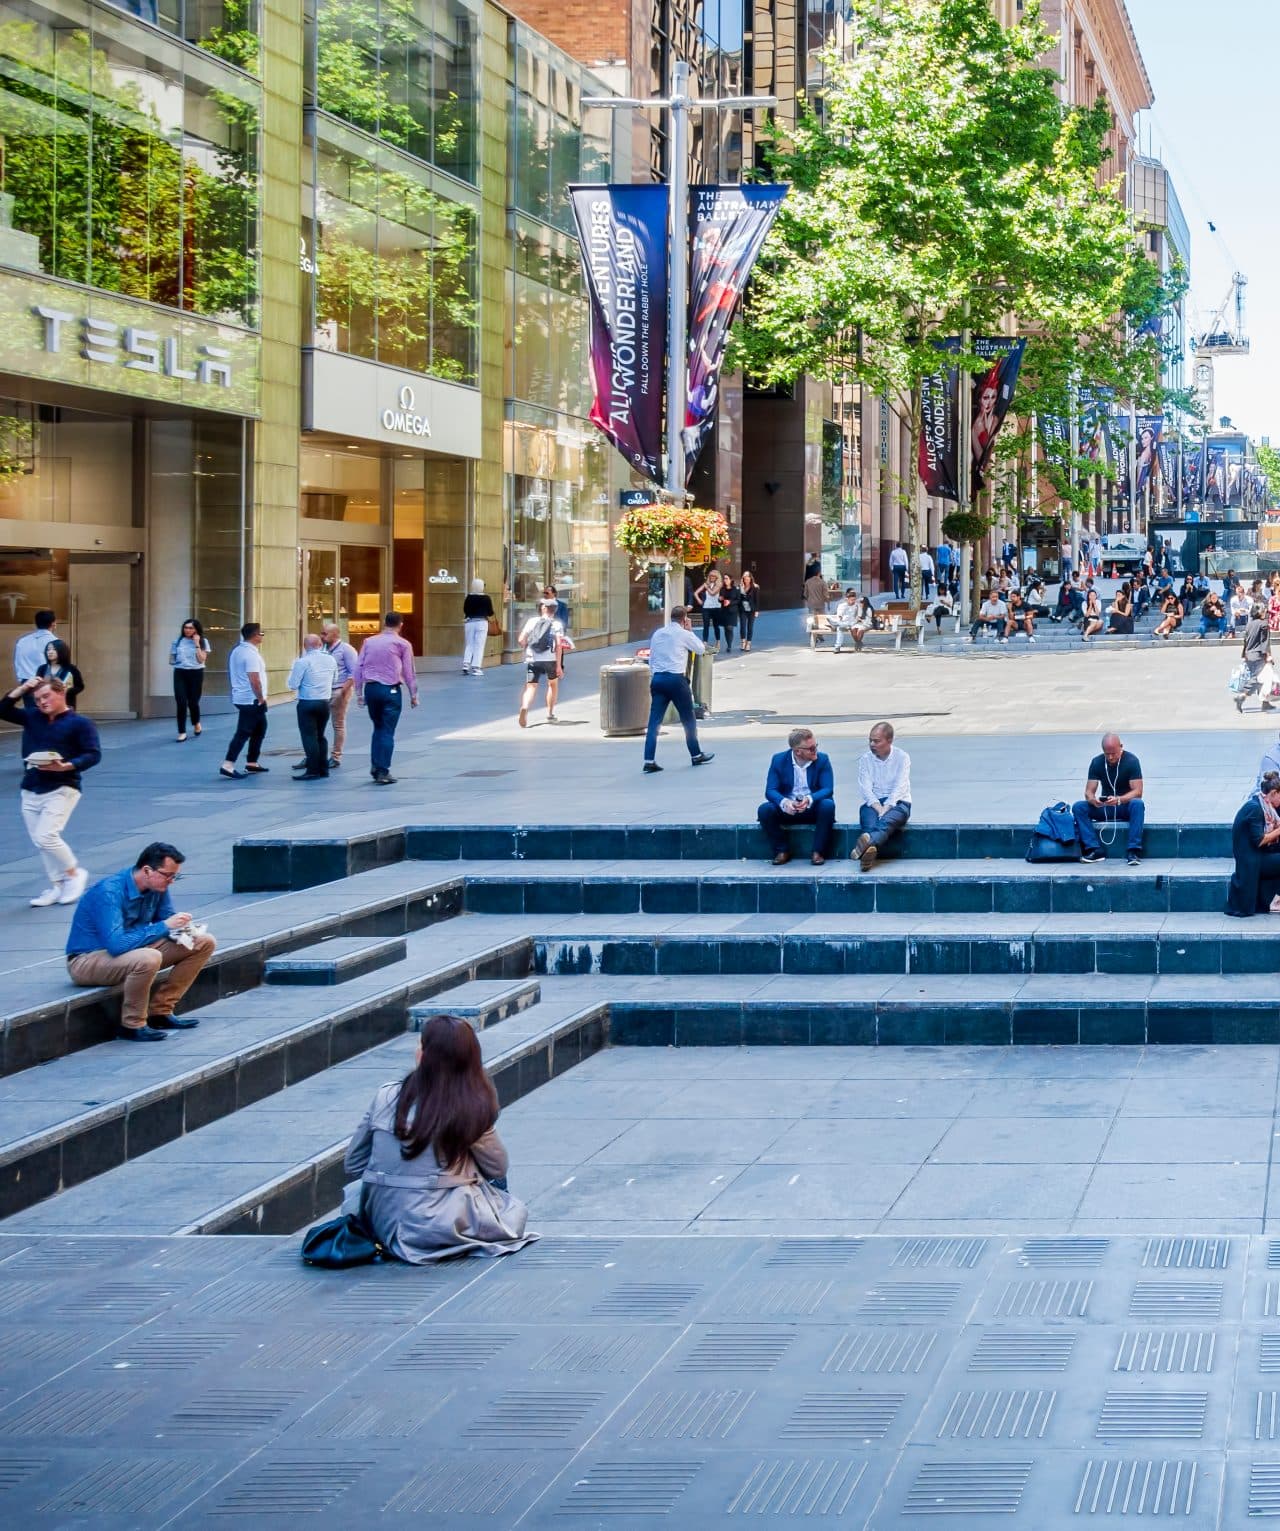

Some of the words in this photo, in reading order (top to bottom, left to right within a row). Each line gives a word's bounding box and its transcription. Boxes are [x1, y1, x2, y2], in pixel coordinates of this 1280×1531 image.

[697, 201, 780, 212] AUSTRALIAN
[698, 191, 723, 201] THE
[697, 211, 744, 222] BALLET
[639, 263, 648, 287] HOLE
[616, 227, 636, 387] WONDERLAND
[640, 290, 649, 321] RABBIT
[641, 323, 649, 340] THE
[32, 305, 231, 387] TESLA
[640, 342, 649, 370] DOWN
[640, 373, 649, 395] FALL
[383, 408, 432, 438] OMEGA
[429, 576, 458, 584] OMEGA
